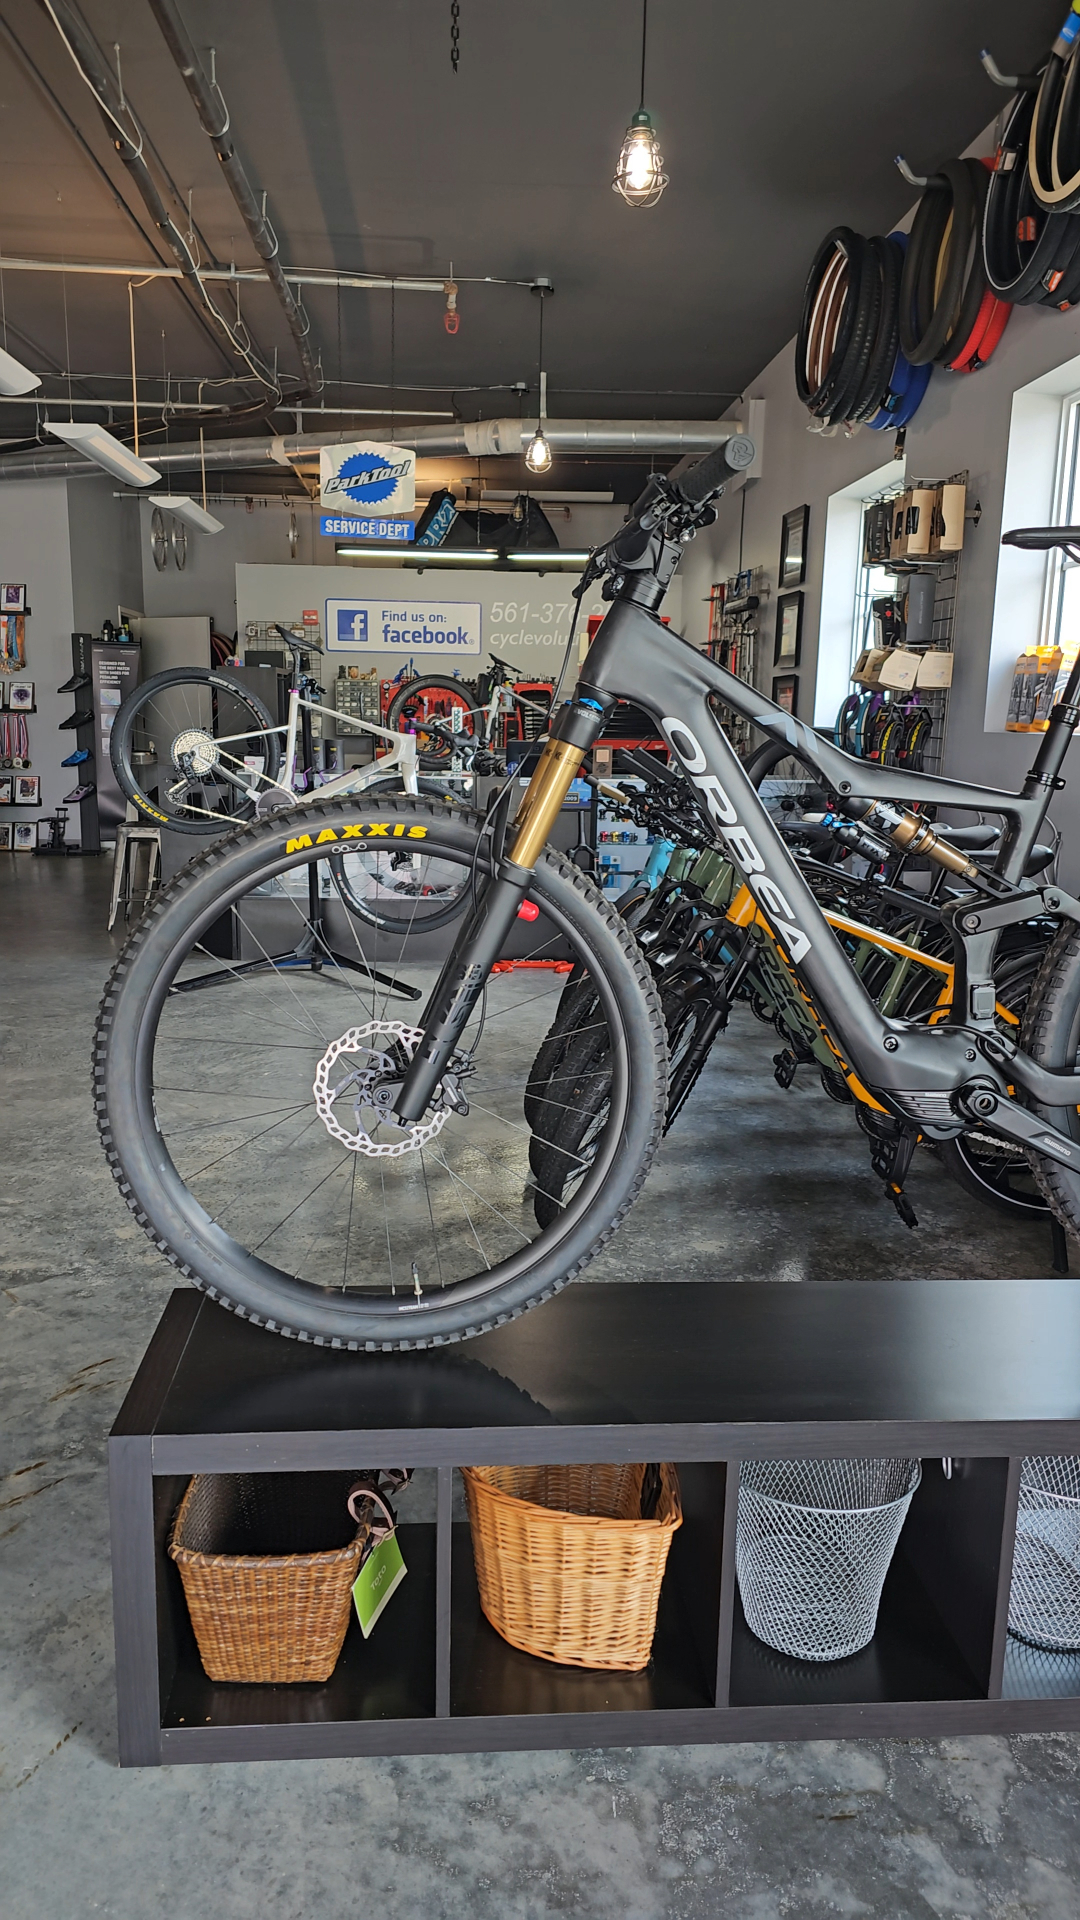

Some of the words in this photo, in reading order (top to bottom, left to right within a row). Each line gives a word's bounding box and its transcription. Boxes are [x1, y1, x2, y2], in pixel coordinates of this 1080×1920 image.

[325, 519, 376, 535] SERVICE
[379, 522, 410, 538] DEPT
[381, 610, 407, 622] Find
[411, 613, 425, 623] us
[428, 613, 447, 623] on:
[490, 601, 612, 624] 561-376-2
[489, 629, 581, 649] cyclevoluti
[285, 823, 429, 854] MAXXIS
[662, 716, 812, 965] ORBEA
[1042, 1137, 1072, 1157] SHIMANO
